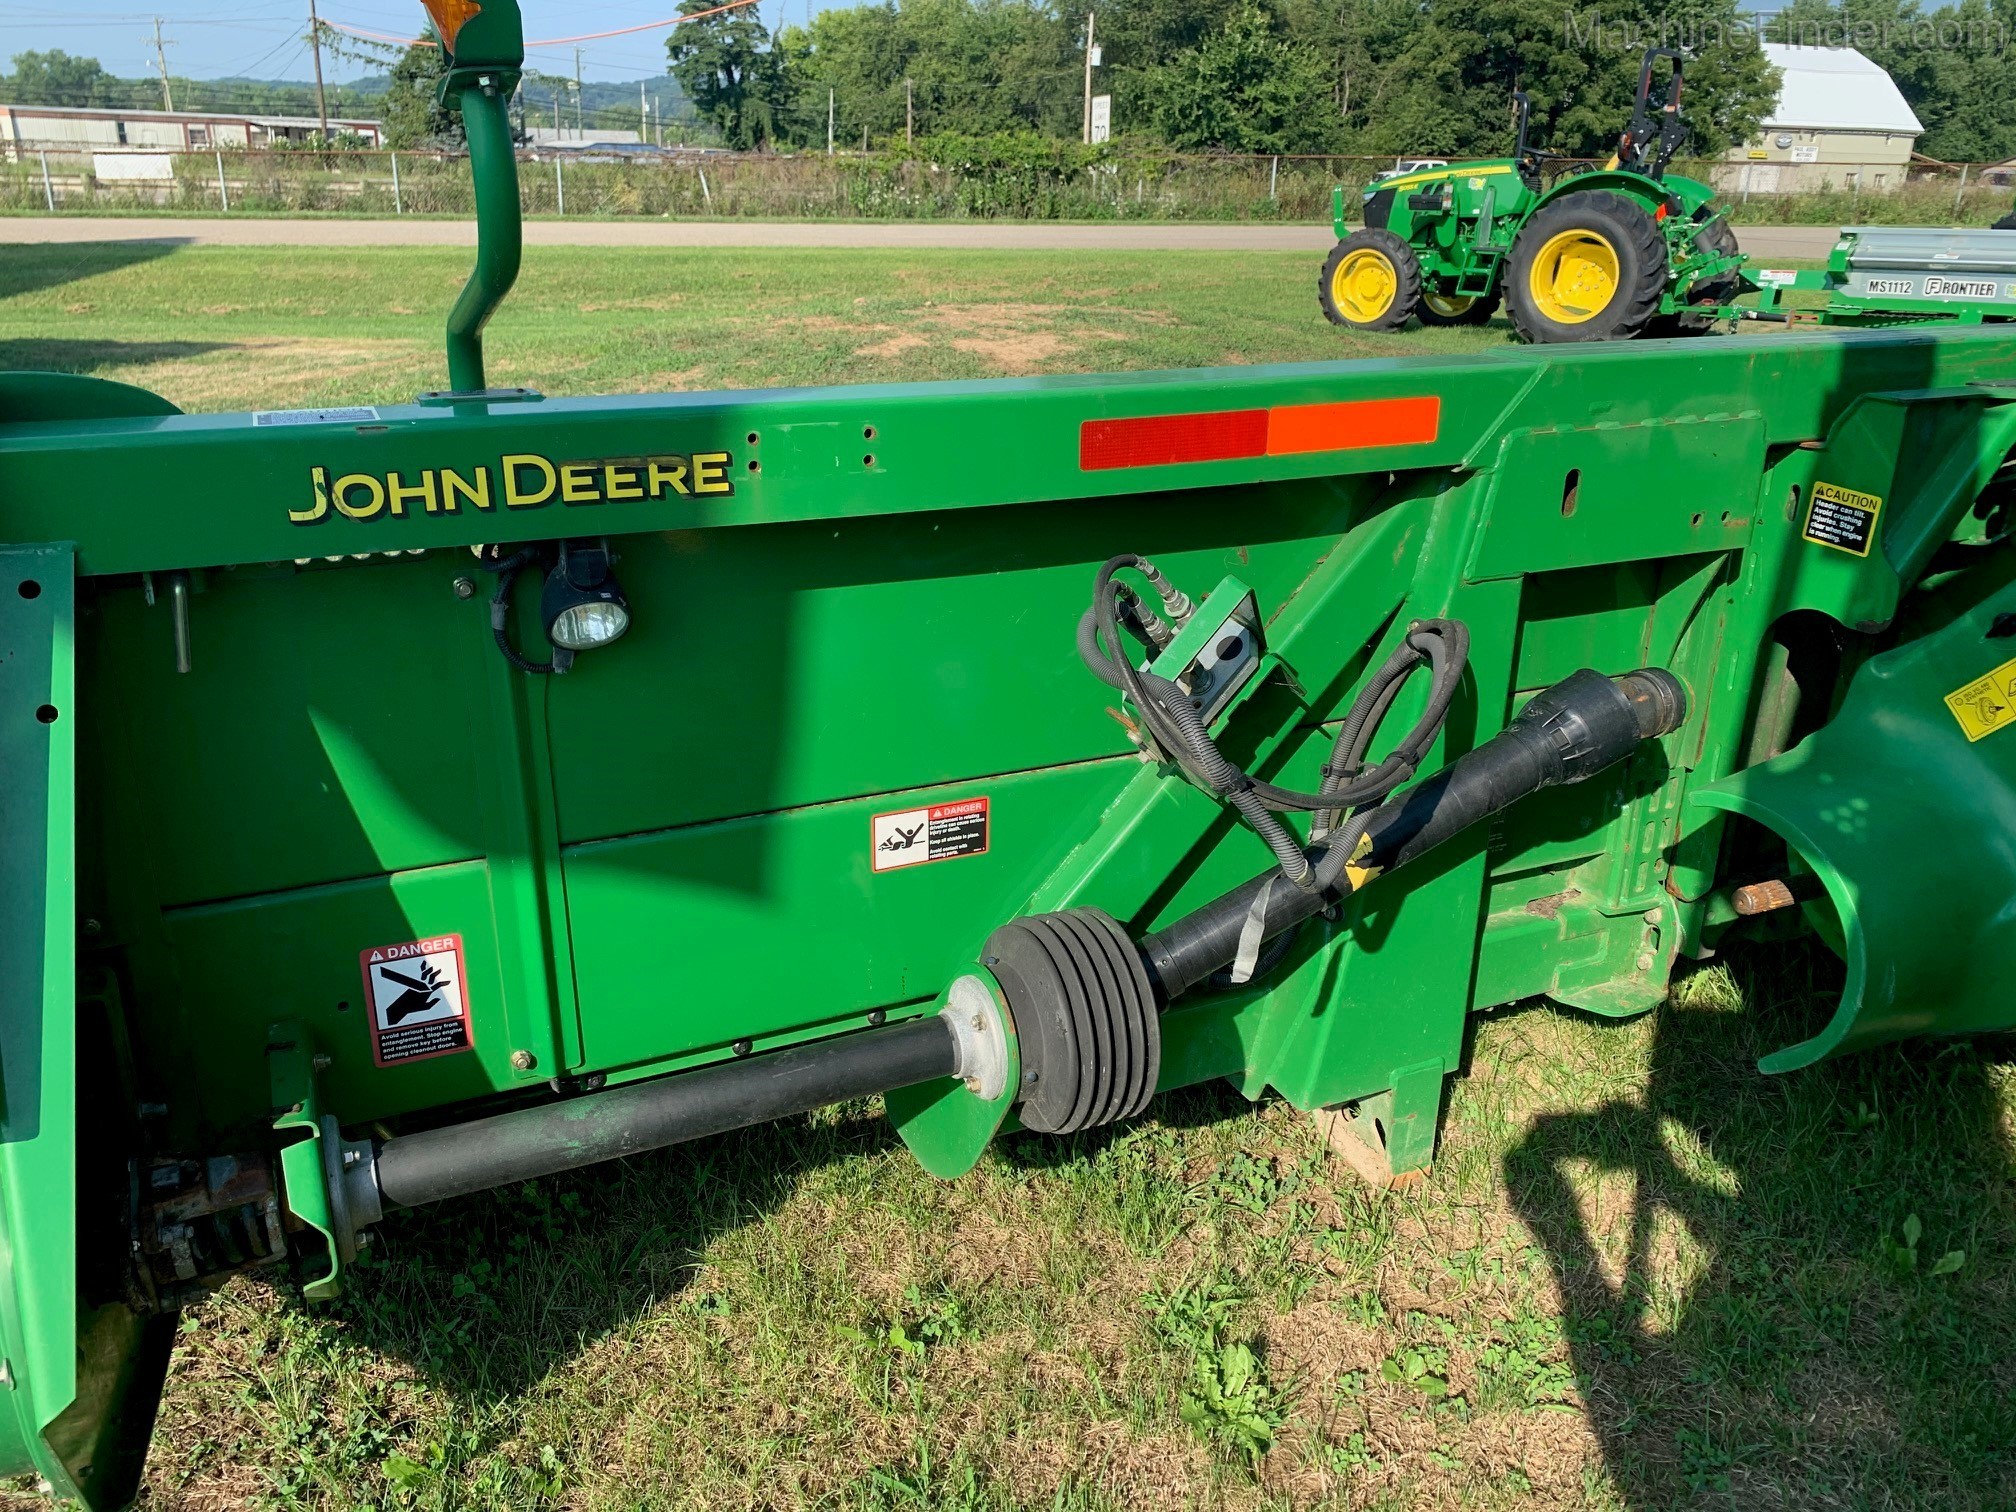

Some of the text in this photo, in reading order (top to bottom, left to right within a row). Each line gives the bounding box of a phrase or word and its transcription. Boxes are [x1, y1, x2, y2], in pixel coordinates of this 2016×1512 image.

[1094, 126, 1106, 140] 70
[1869, 281, 1912, 294] MS1112
[1925, 278, 1995, 296] FRONTIER
[288, 453, 733, 524] JOHN DEERE
[1826, 488, 1878, 510] CAUTION
[1814, 506, 1862, 526] Avoid crushing
[1816, 499, 1866, 519] Header can tilt.
[1810, 521, 1862, 541] clear when engine
[1812, 514, 1855, 532] injuries. Stay
[1815, 531, 1840, 543] running.
[944, 802, 982, 816] DANGER
[387, 938, 454, 959] DANGER
[381, 1032, 400, 1041] Avoid
[424, 1025, 442, 1033] injury
[382, 1035, 426, 1047] entanglement.
[442, 1028, 462, 1036] engine
[396, 1043, 418, 1051] remove
[432, 1036, 452, 1044] before
[384, 1050, 409, 1060] opening
[410, 1046, 437, 1054] cleanout
